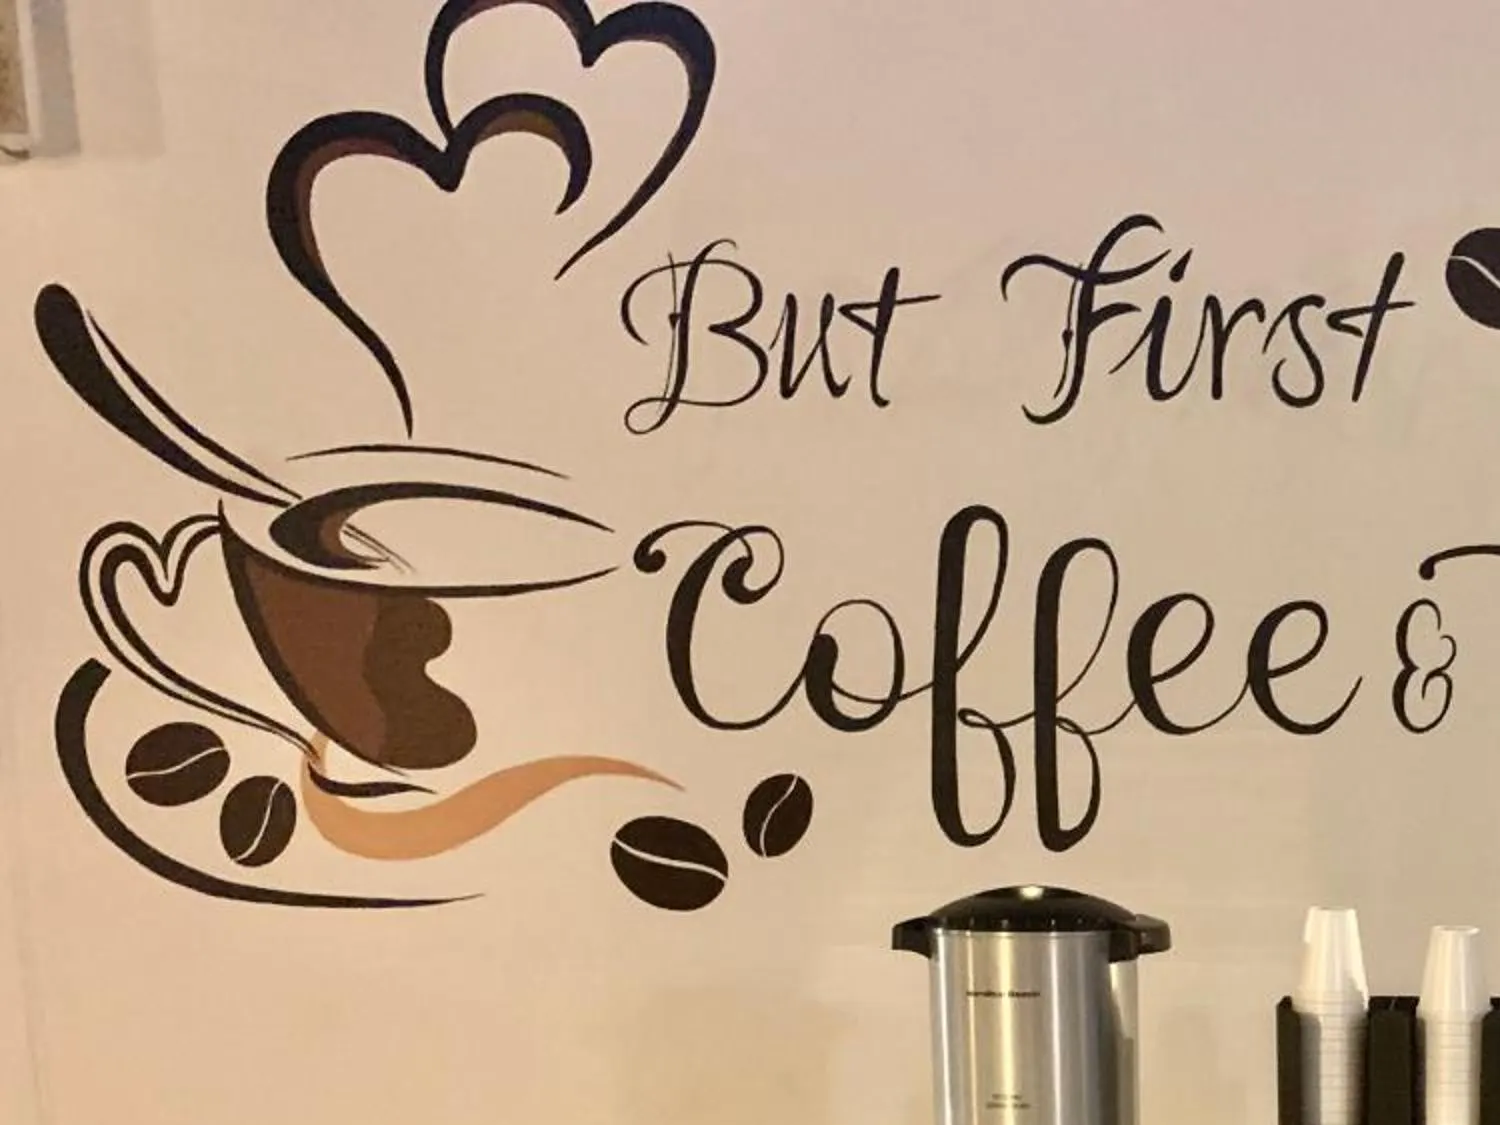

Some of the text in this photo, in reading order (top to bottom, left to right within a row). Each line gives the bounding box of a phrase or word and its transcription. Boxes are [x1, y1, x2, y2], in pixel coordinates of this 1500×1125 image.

[621, 213, 1416, 435] But First
[632, 504, 1363, 853] Coffee
[1391, 598, 1457, 735] &
